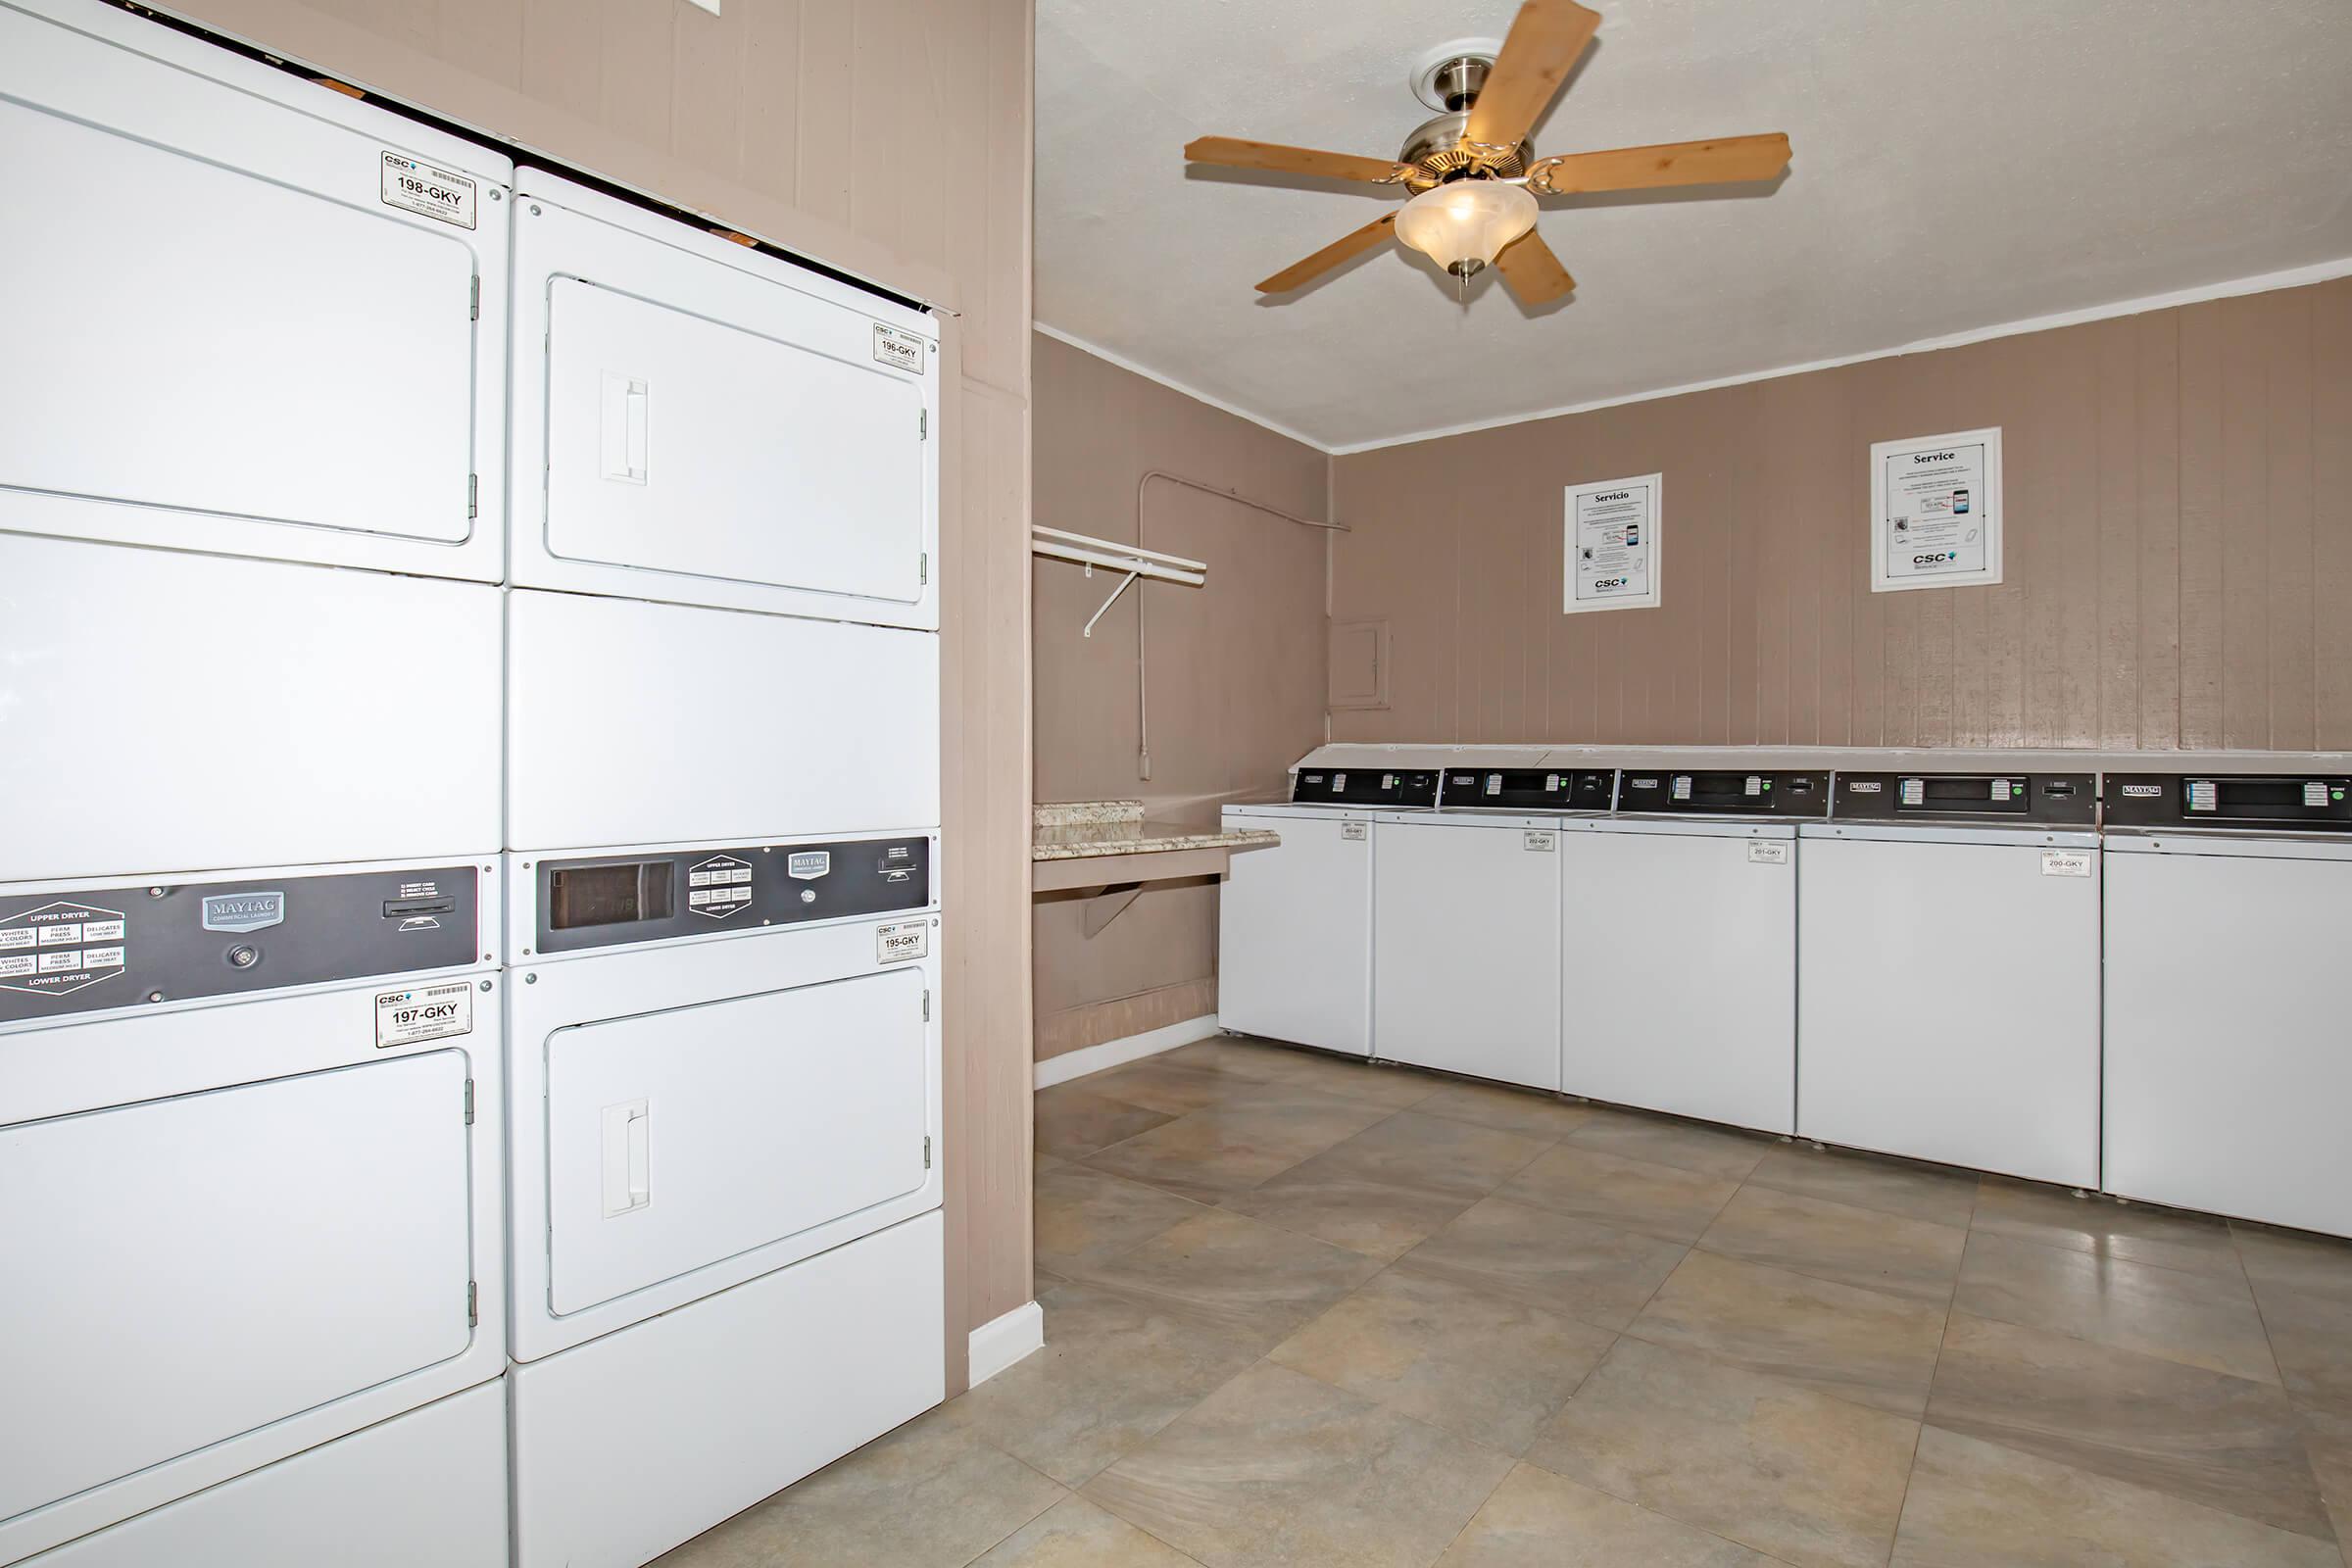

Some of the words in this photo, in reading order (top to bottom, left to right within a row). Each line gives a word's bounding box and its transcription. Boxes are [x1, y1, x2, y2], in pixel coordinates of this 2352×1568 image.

[384, 155, 410, 169] CSC
[398, 176, 462, 206] 198-GKY
[876, 325, 889, 334] CSC
[882, 340, 916, 358] 196-GKY
[1914, 452, 1955, 465] Service
[1595, 491, 1629, 503] Servicio
[1913, 554, 1945, 564] CSC
[1594, 579, 1620, 588] CSC
[794, 858, 825, 867] MAYTAG
[213, 900, 275, 914] MAYTAG
[30, 912, 60, 922] UPPER
[213, 912, 249, 921] COMMERCIAL
[885, 935, 920, 949] 195-GKY
[28, 976, 60, 986] LOWER
[62, 973, 91, 982] DRYER
[379, 995, 404, 1004] CSC
[393, 1004, 458, 1024] 197-GKY
